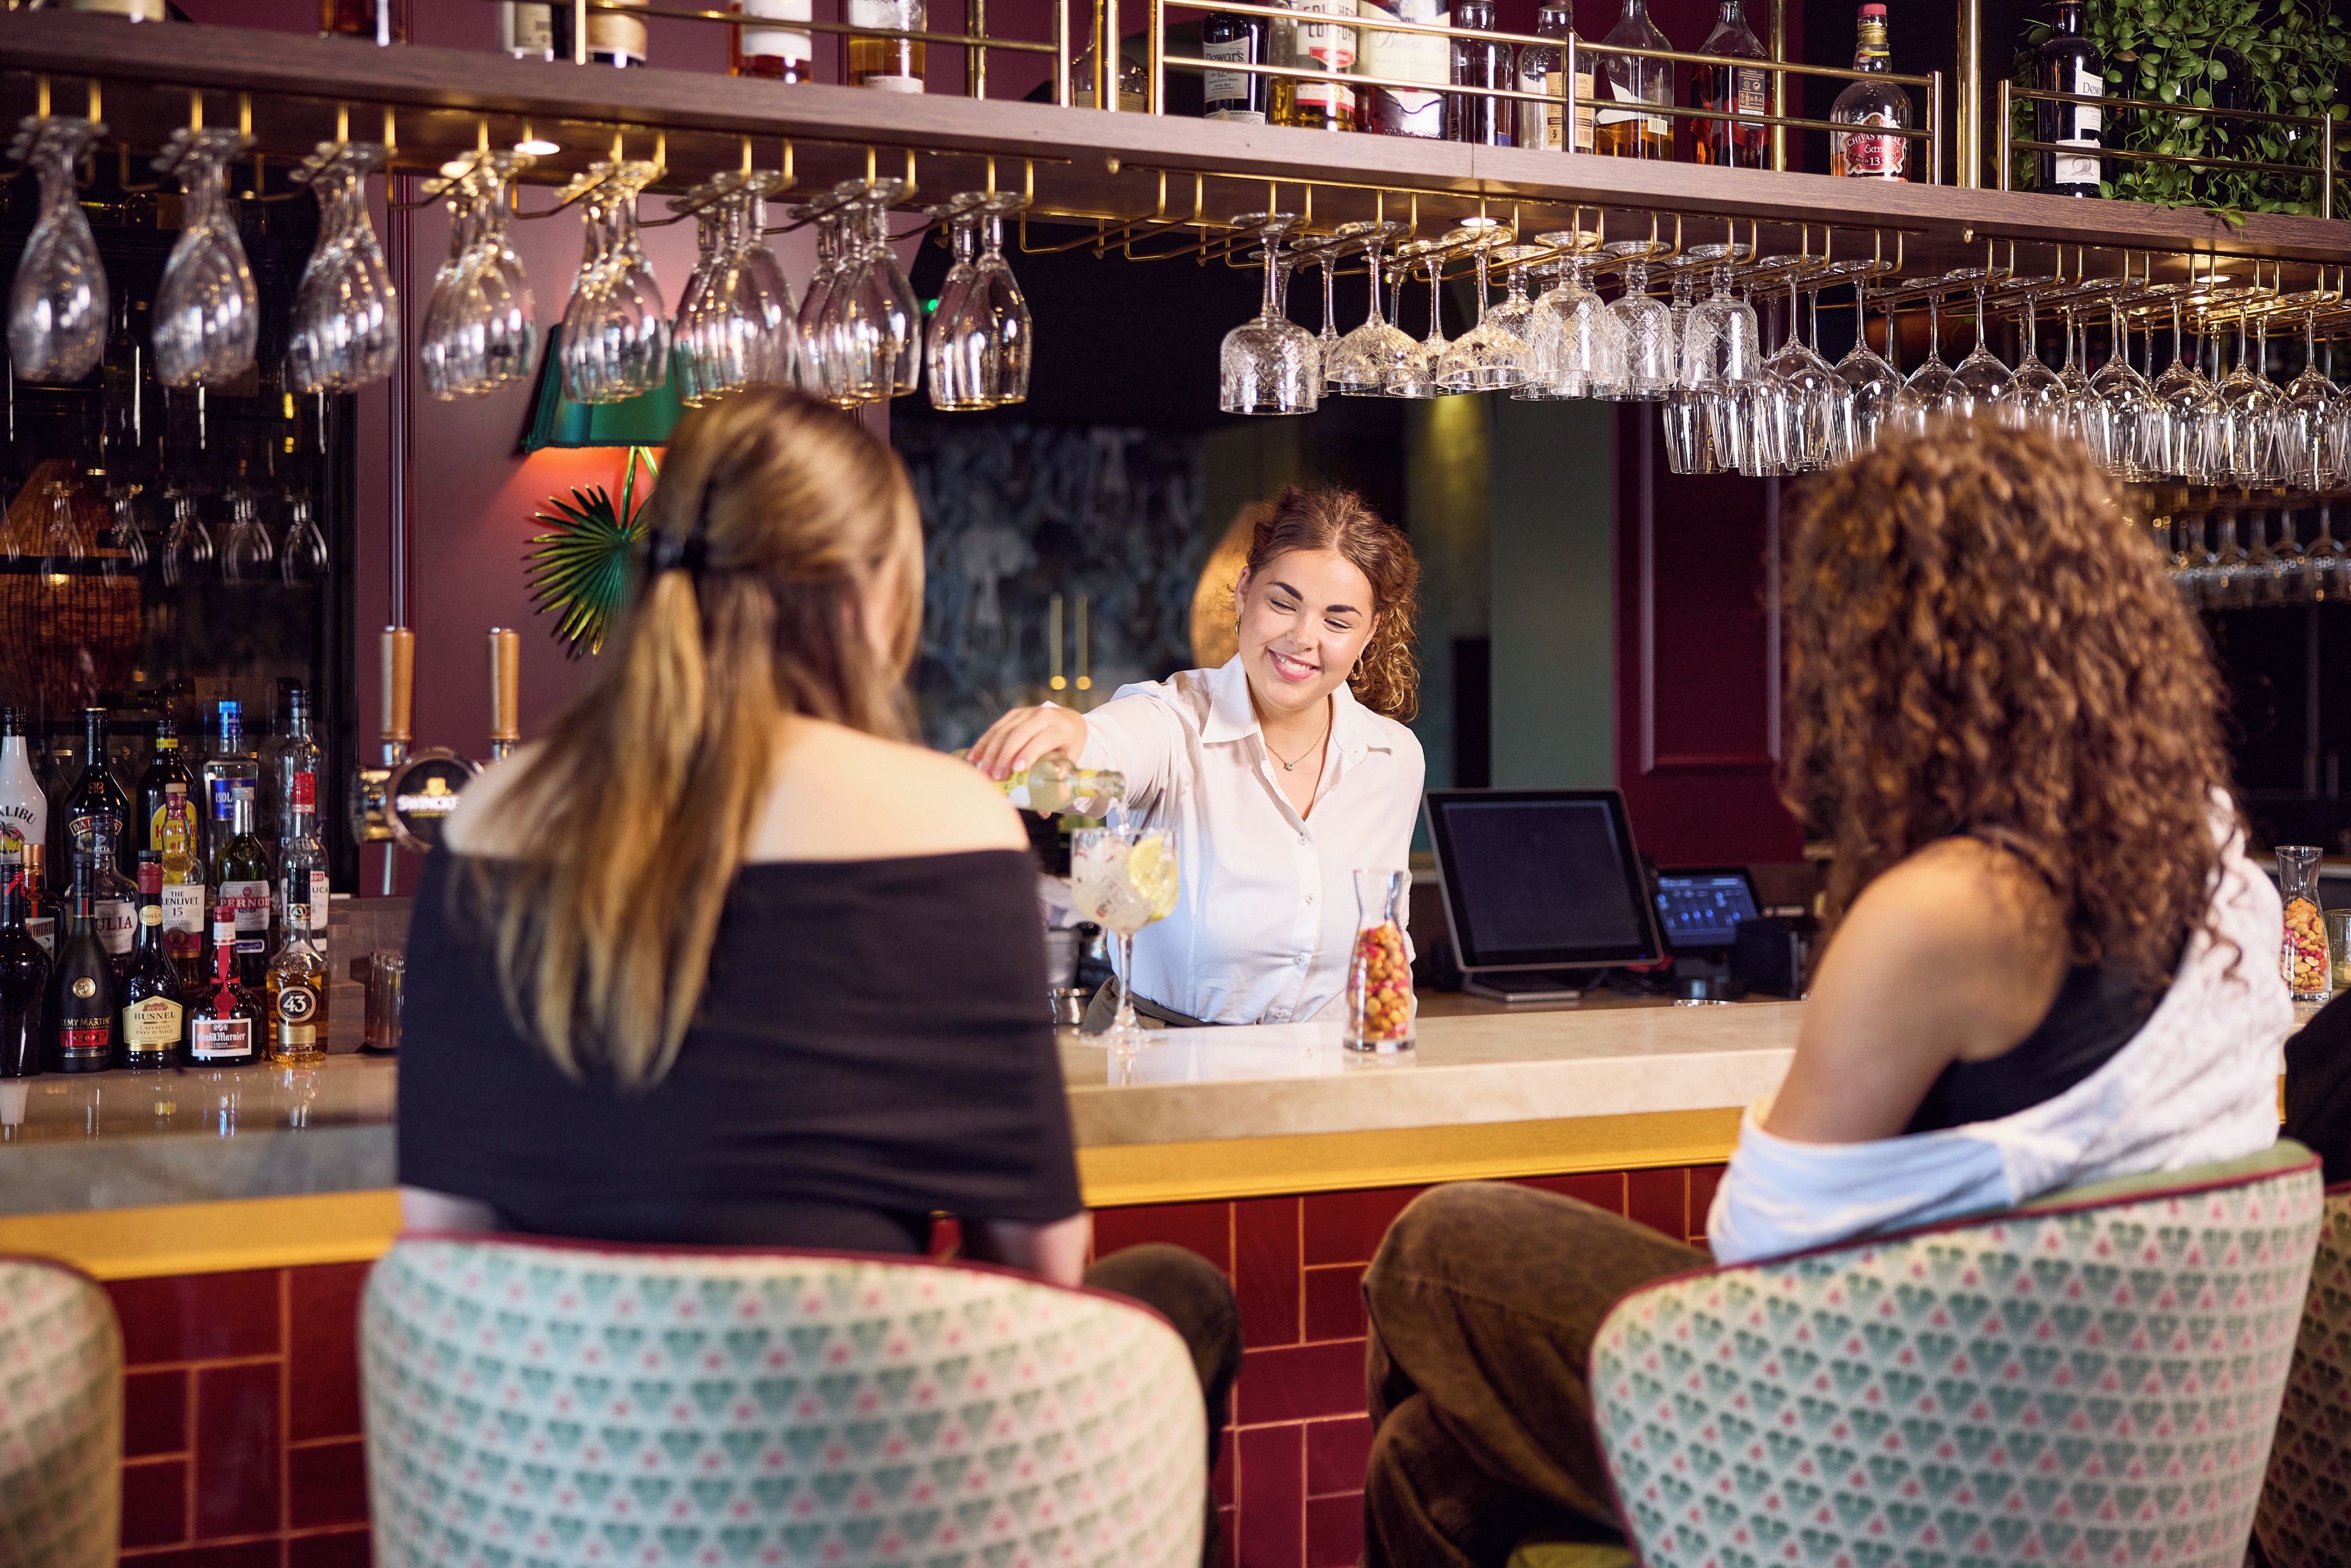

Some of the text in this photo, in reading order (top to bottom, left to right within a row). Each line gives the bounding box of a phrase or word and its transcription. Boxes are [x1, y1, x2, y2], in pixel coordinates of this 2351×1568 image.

[1847, 133, 1875, 146] CHIVAS
[1870, 157, 1881, 166] 13
[161, 897, 198, 906] LENLIVET
[220, 898, 269, 908] PERNOD
[173, 907, 184, 917] 15
[94, 916, 133, 931] ULIA
[282, 994, 307, 1013] 43
[134, 1011, 176, 1020] BUSNEL
[80, 1017, 110, 1026] MARTIN
